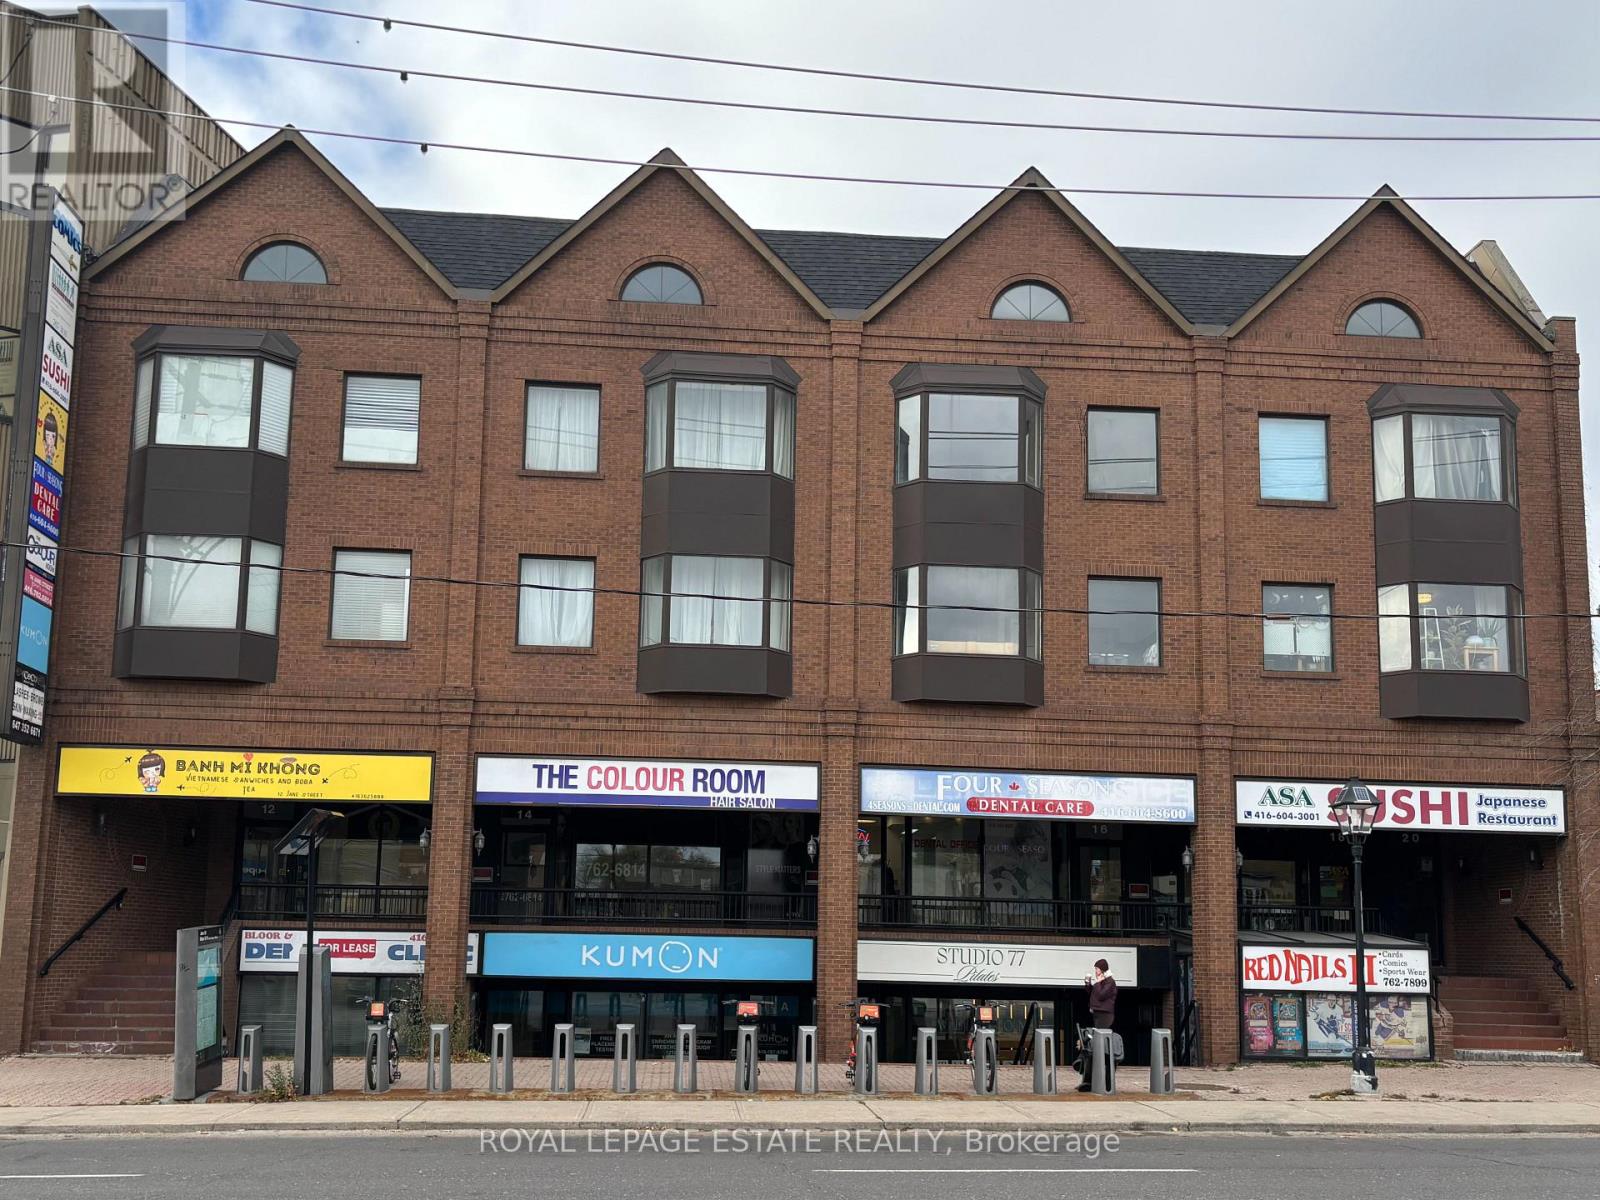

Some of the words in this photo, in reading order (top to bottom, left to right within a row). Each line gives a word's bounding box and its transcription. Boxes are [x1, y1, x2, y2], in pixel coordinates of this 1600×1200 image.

[48, 338, 68, 368] ASA
[43, 354, 70, 393] SUSHI
[34, 481, 59, 510] DENTAL
[37, 499, 56, 522] CARE
[20, 624, 47, 646] KUMON
[176, 759, 225, 773] BANH
[186, 772, 229, 783] VIETNAMESE
[278, 777, 292, 785] AND
[532, 764, 579, 789] THE
[586, 765, 685, 792] COLOUR
[692, 768, 766, 795] ROOM
[243, 785, 256, 796] TEA
[286, 789, 299, 798] JANE
[937, 775, 1001, 800] FOUR
[1026, 776, 1127, 798] SEASONS
[710, 796, 737, 808] HAIR
[739, 797, 776, 809] SALON
[1259, 787, 1314, 806] ASA
[1477, 794, 1547, 809] Japanese
[262, 804, 275, 814] 12
[978, 799, 1038, 812] DENTAL
[1045, 801, 1083, 814] CARE
[517, 809, 532, 820] 14
[1254, 811, 1320, 821] 416-604-3001
[1478, 812, 1557, 826] Restaurant
[914, 839, 947, 848] DENTAL
[585, 861, 647, 877] 762-6814
[244, 931, 284, 940] BLOOR
[284, 931, 293, 940] &
[409, 933, 427, 942] 416
[342, 943, 376, 954] LEASE
[1382, 951, 1403, 959] Cards
[581, 941, 718, 973] KUMON
[936, 948, 1004, 965] STUDIO
[1008, 950, 1026, 966] 77
[1382, 959, 1408, 967] Comics
[953, 965, 1000, 982] Pilates
[1245, 953, 1282, 981] RED
[1283, 949, 1347, 985] NAILS
[1382, 967, 1406, 976] Sports
[1407, 968, 1427, 976] Wear
[1383, 977, 1428, 987] 762-7899
